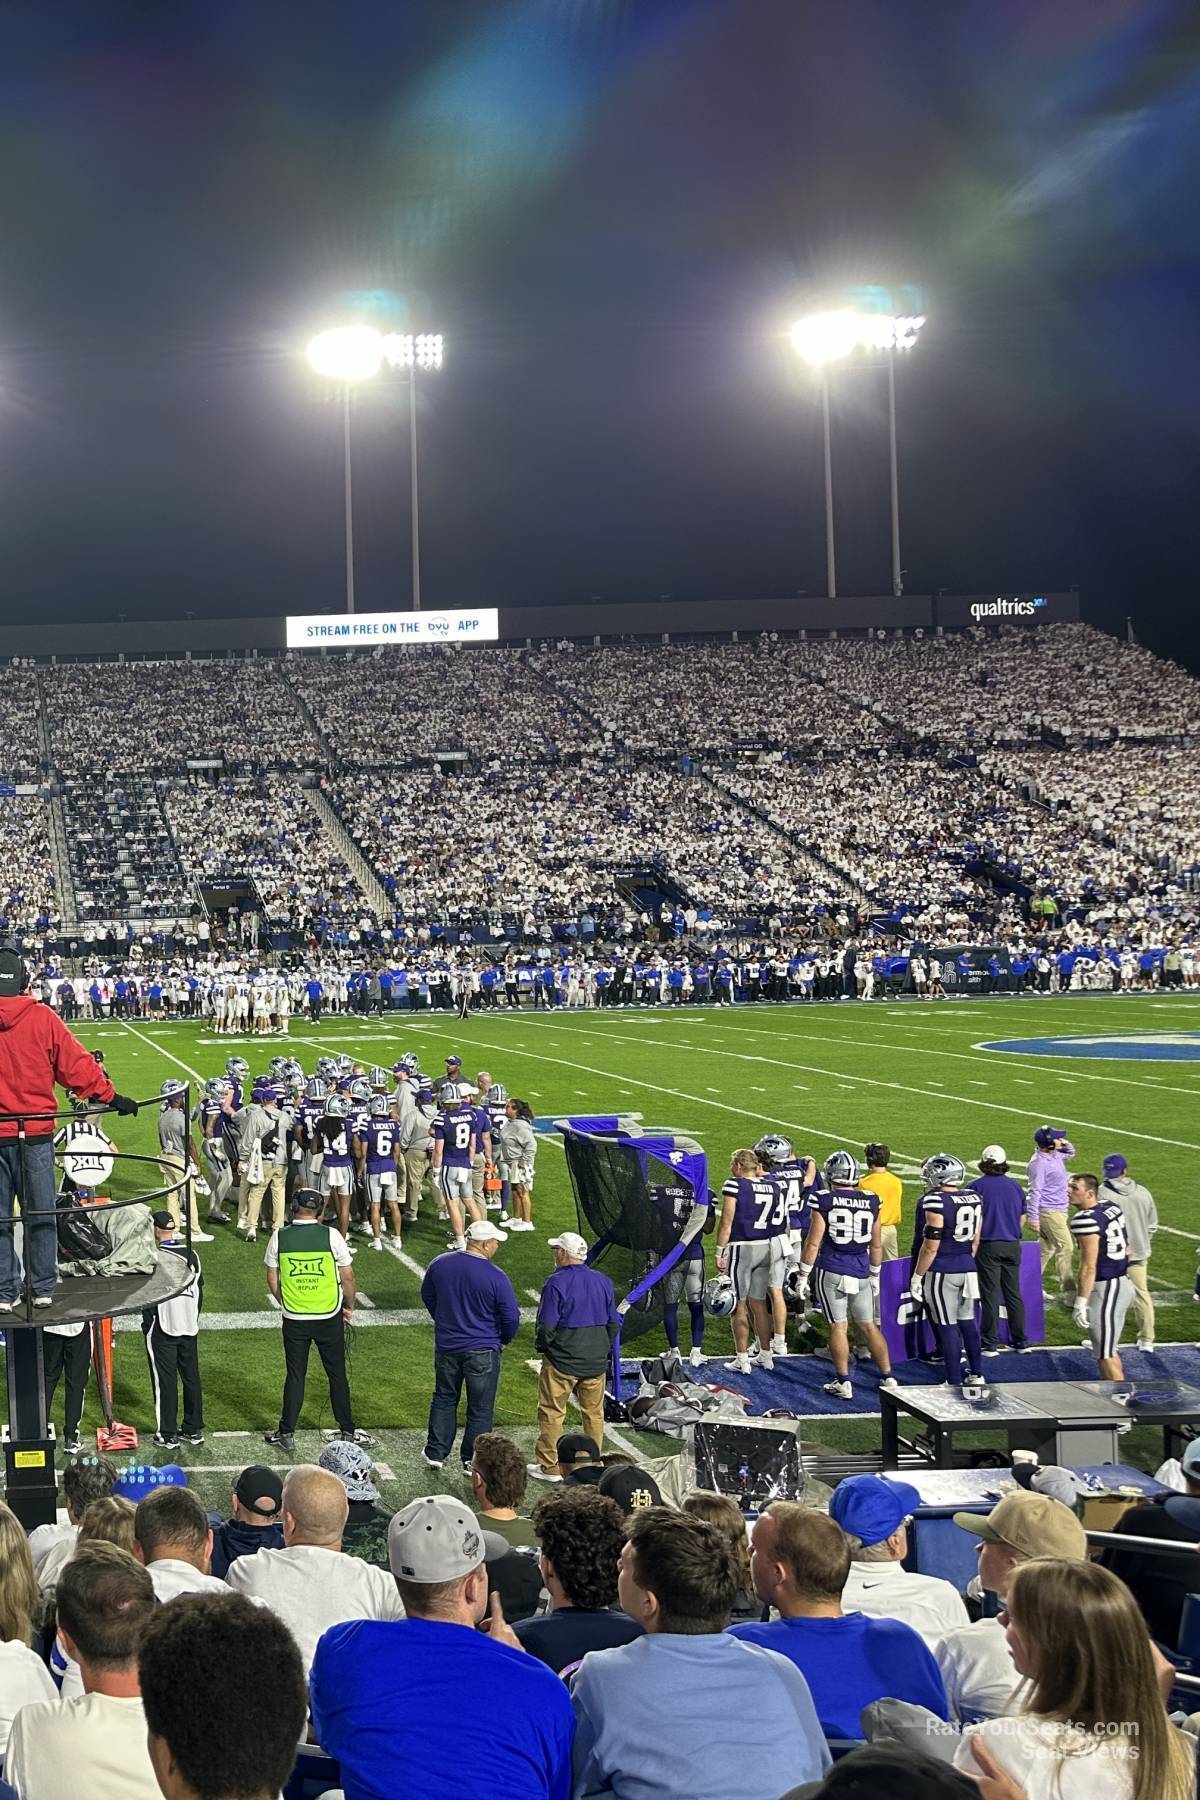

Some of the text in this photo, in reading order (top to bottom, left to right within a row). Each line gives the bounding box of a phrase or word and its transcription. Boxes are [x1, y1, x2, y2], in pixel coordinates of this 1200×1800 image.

[970, 598, 1035, 621] qualtrics
[307, 625, 350, 637] STREAM
[353, 624, 379, 635] FREE
[382, 623, 397, 634] ON
[400, 622, 420, 633] THE
[458, 620, 479, 631] APP
[377, 1131, 392, 1156] 6
[455, 1123, 470, 1149] 8
[833, 1197, 870, 1209] ANCIAUX
[828, 1208, 874, 1244] 80
